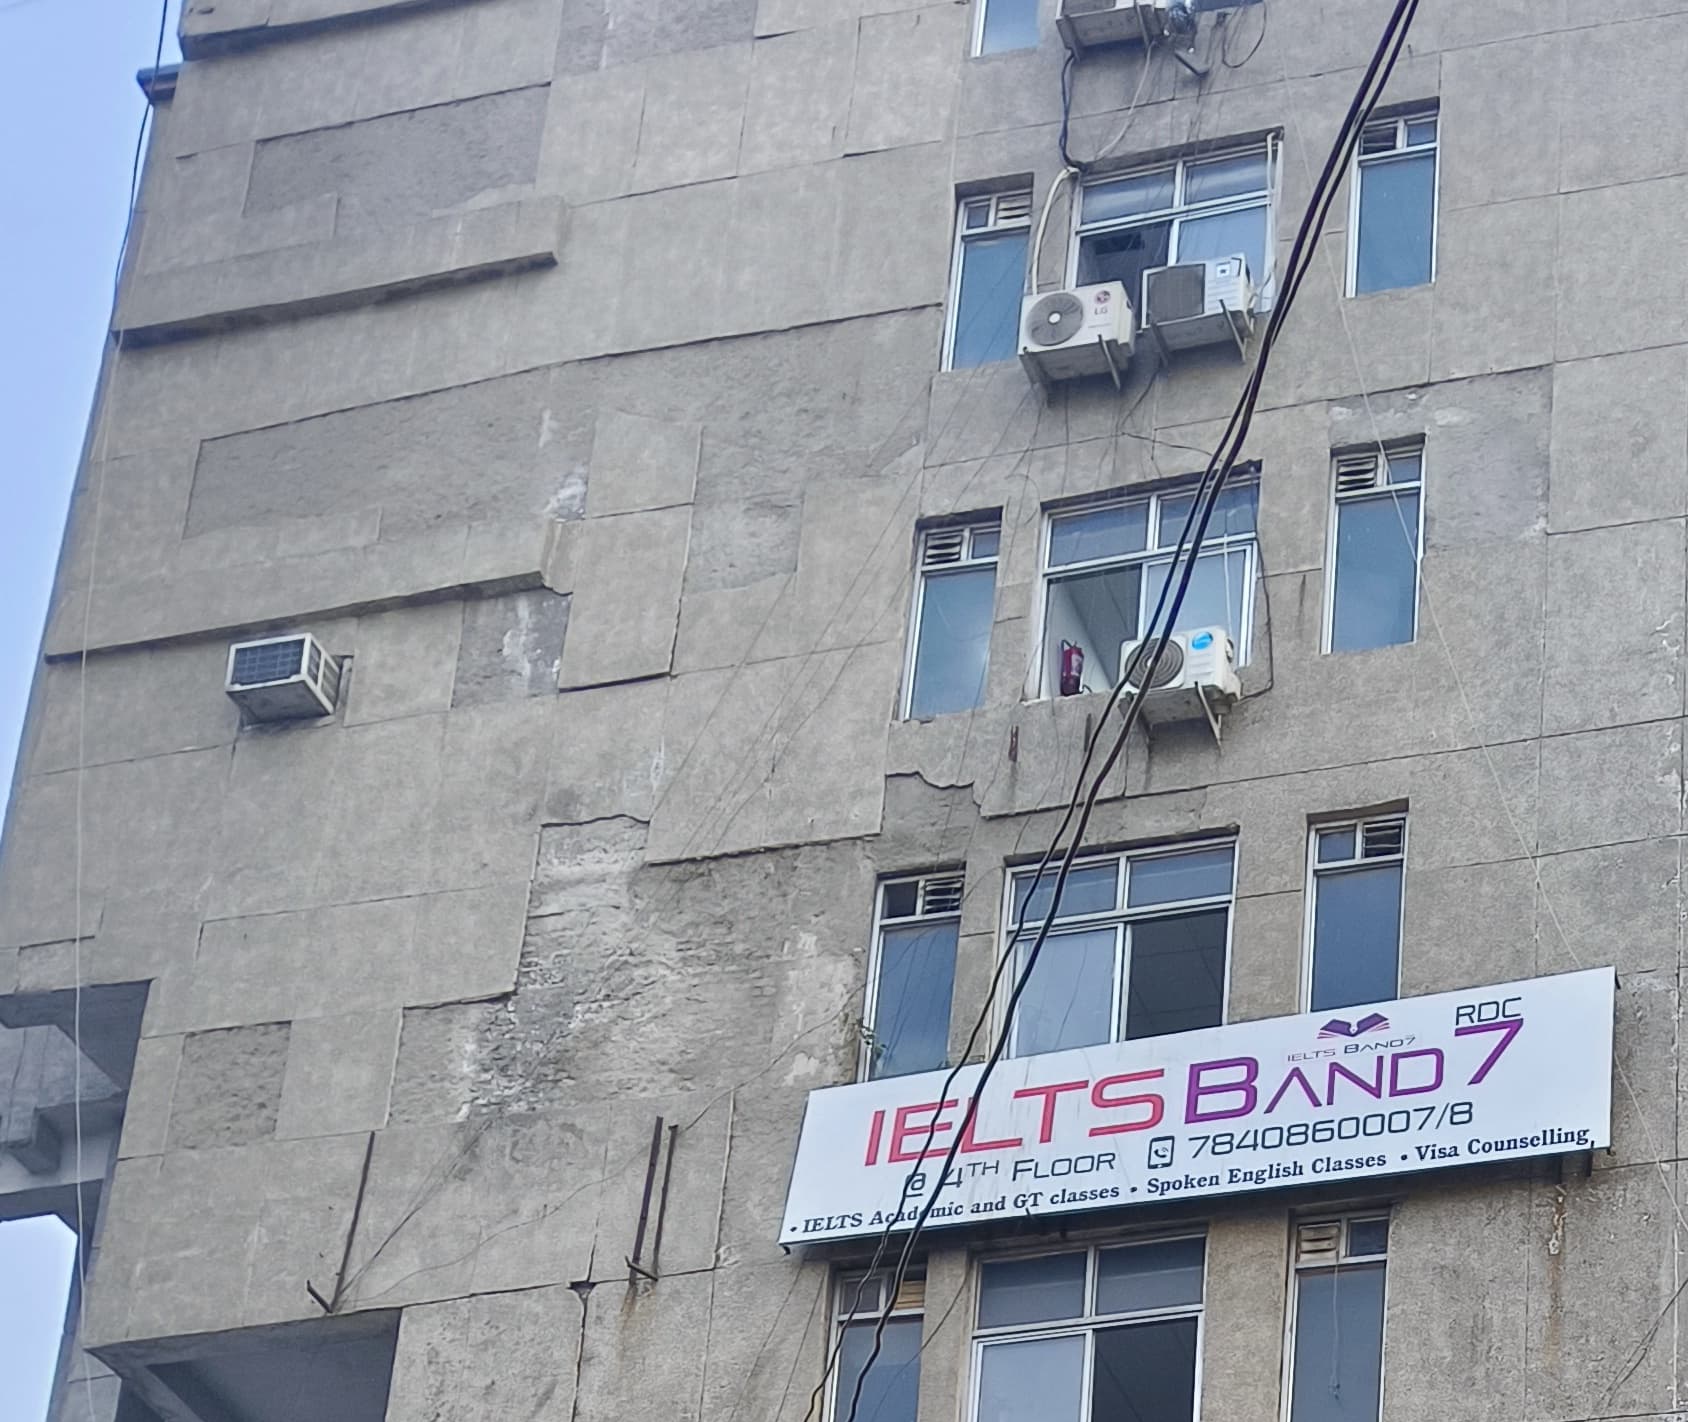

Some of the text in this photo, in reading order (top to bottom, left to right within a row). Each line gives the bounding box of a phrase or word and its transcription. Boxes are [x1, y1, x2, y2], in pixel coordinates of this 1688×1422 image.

[1455, 998, 1523, 1026] RDC
[863, 1069, 1164, 1167] IELTS
[1188, 1103, 1474, 1159] 7840860007/8
[1012, 1152, 1116, 1183] FLOOR
